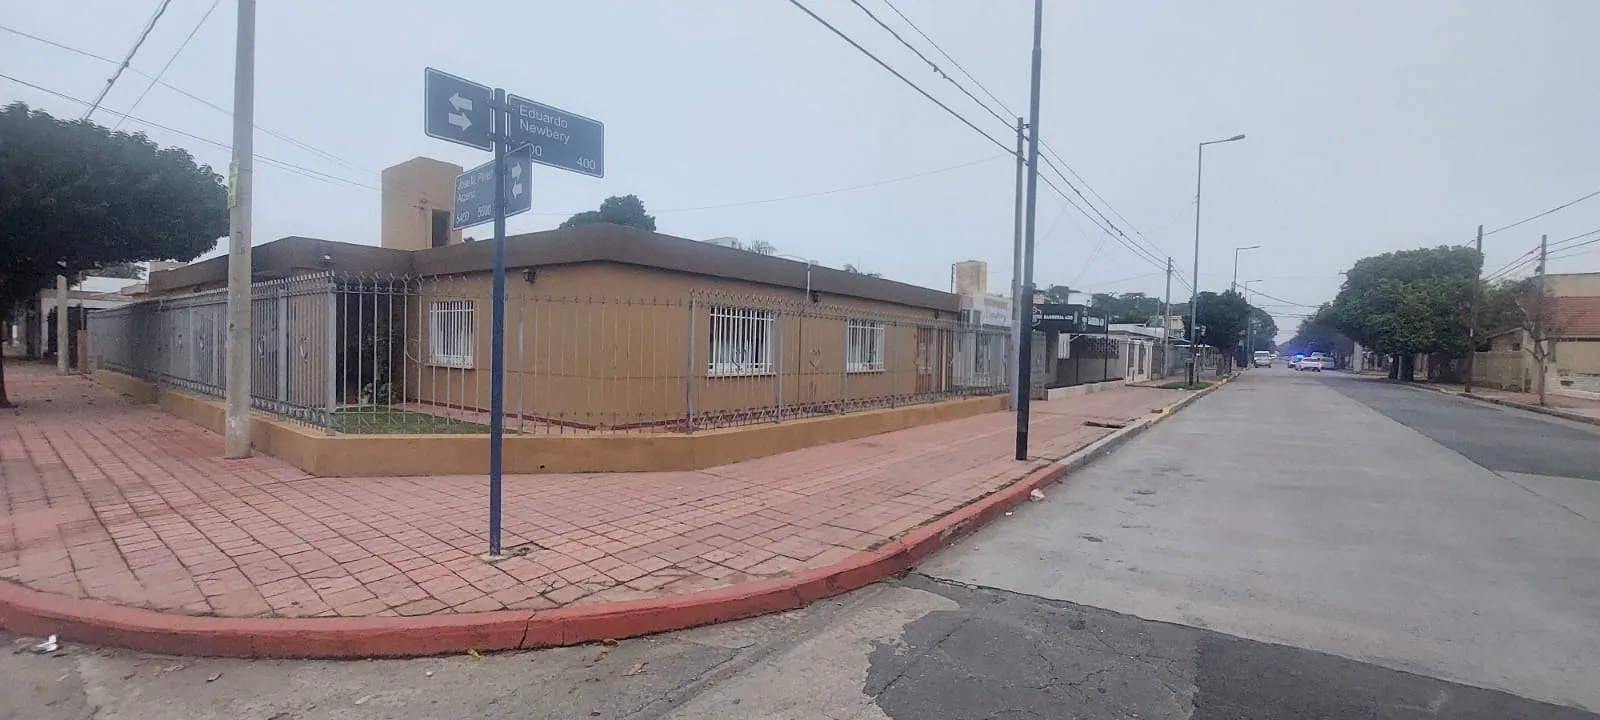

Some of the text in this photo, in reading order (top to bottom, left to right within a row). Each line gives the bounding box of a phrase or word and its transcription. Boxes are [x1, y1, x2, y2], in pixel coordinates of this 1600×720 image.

[519, 104, 568, 129] Eduardo
[519, 118, 570, 145] Newbery
[576, 156, 596, 170] 400
